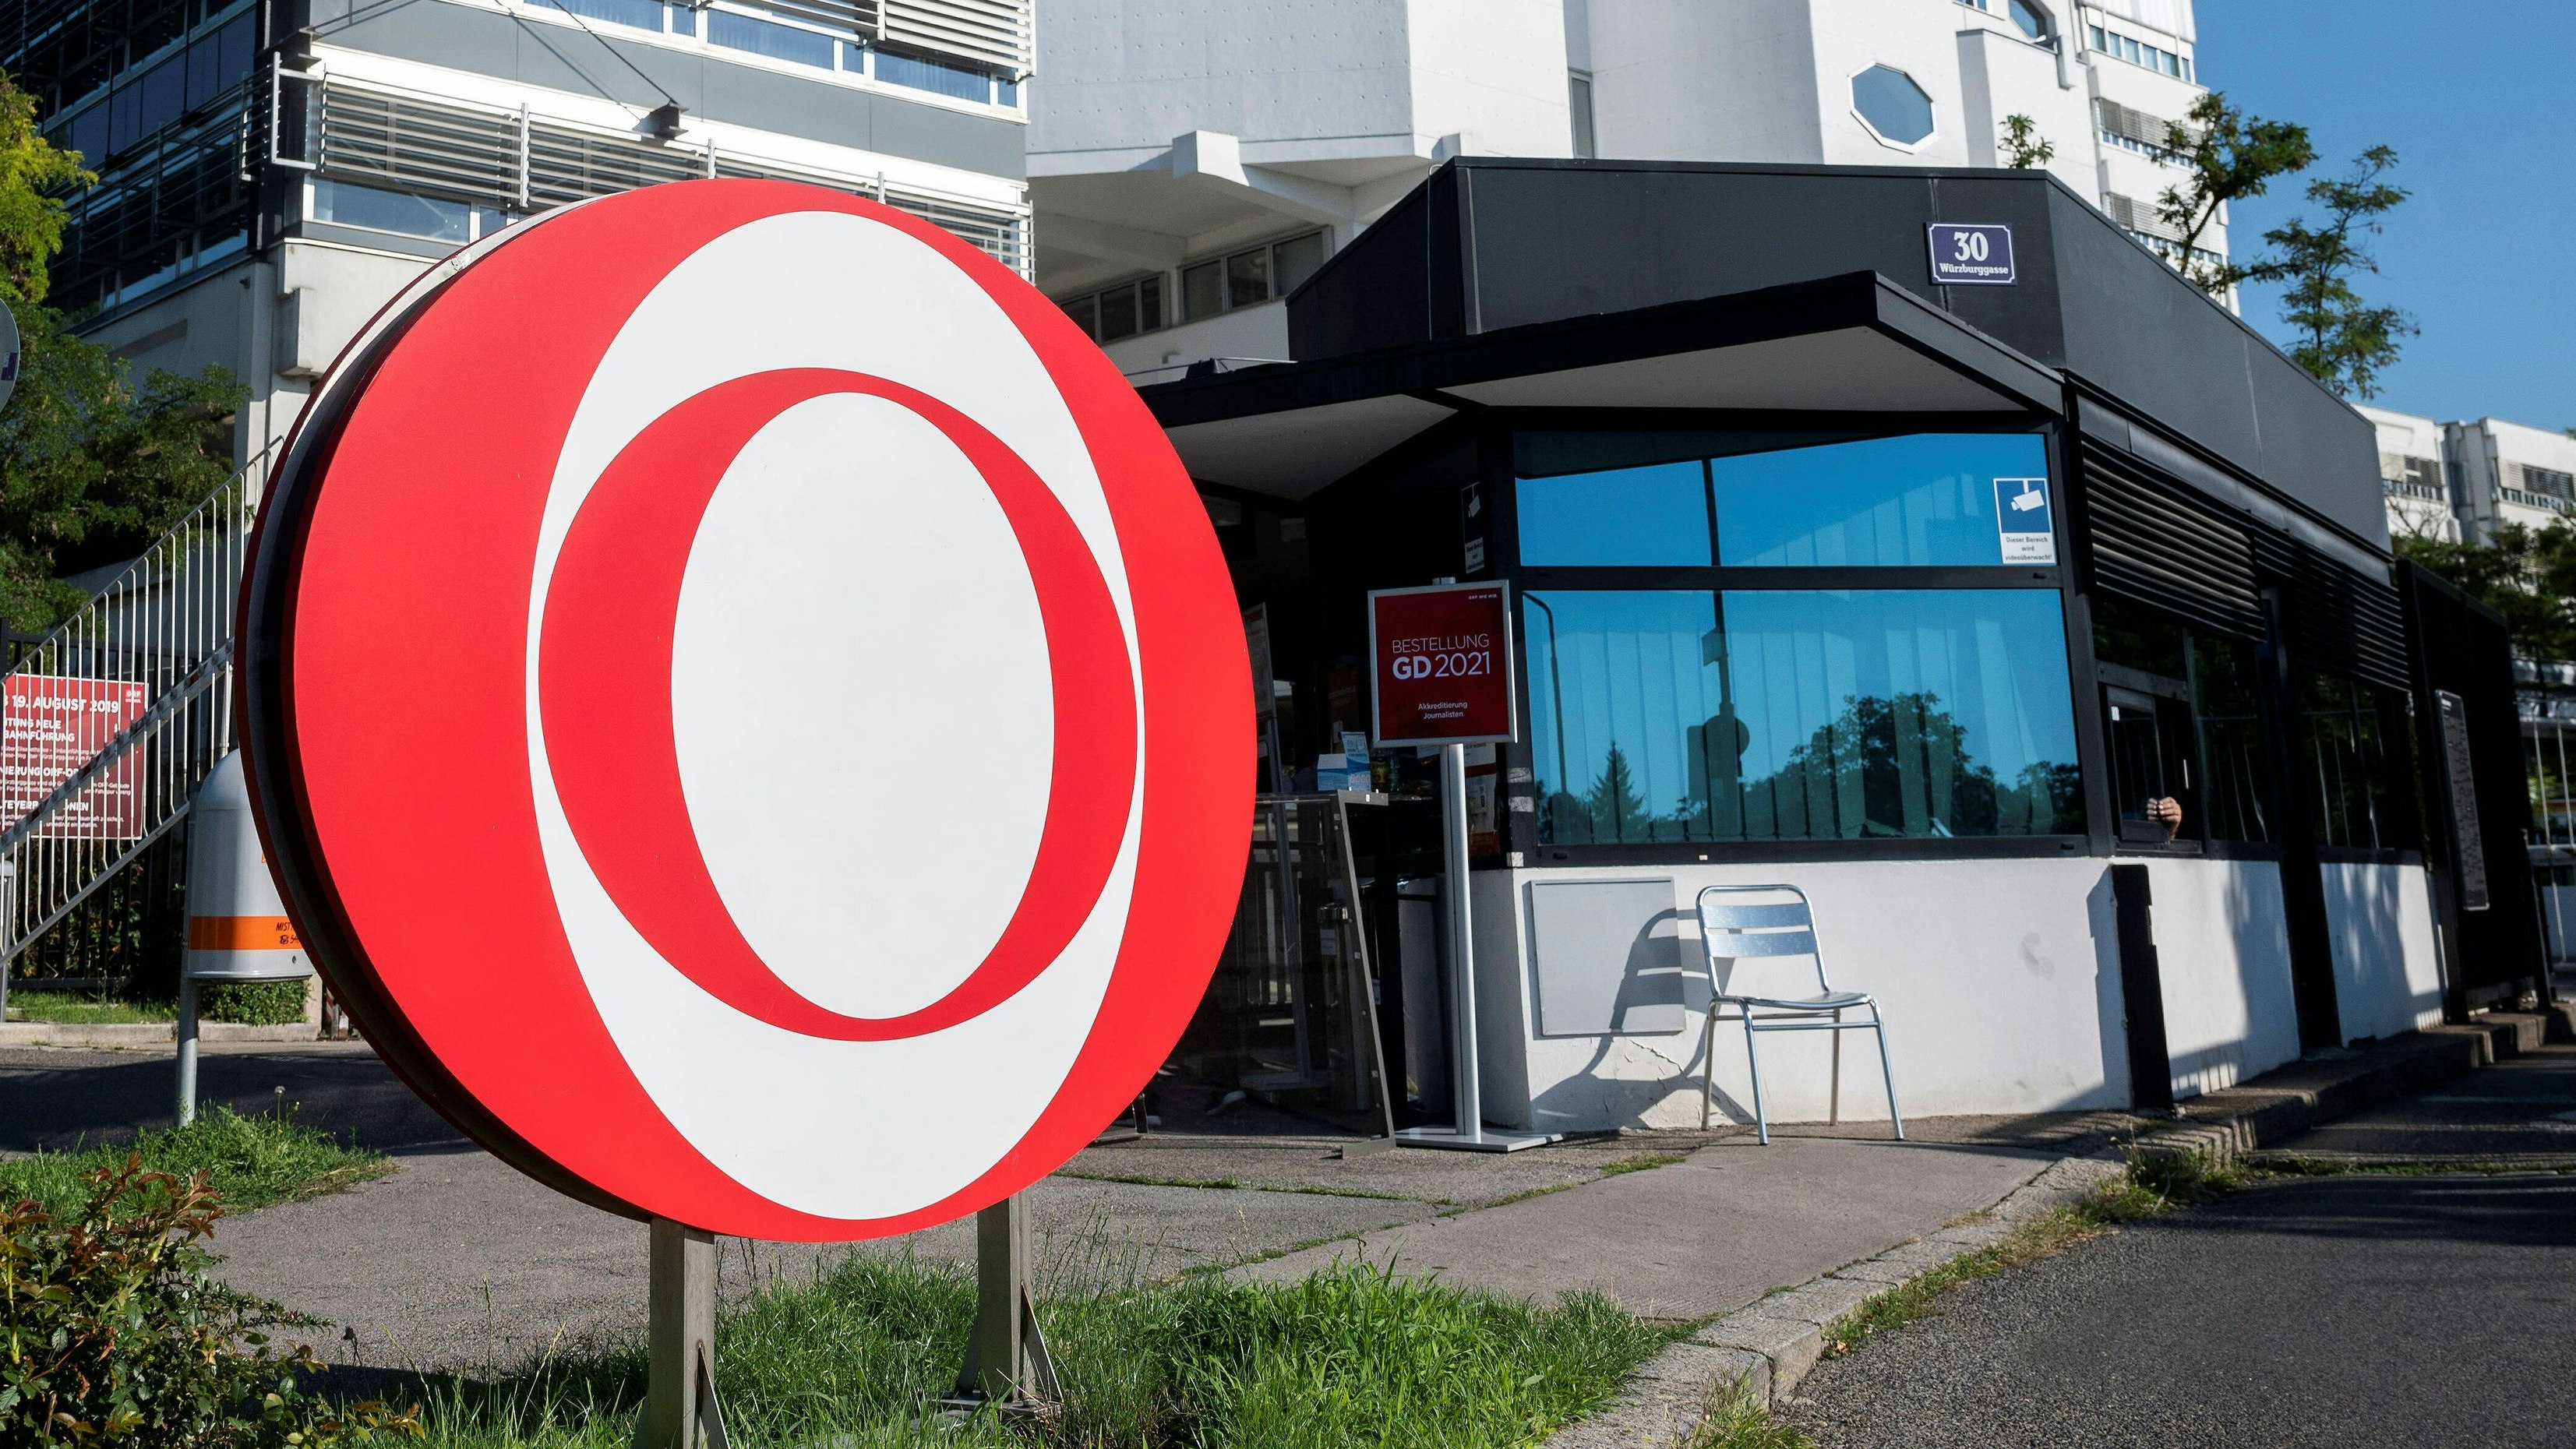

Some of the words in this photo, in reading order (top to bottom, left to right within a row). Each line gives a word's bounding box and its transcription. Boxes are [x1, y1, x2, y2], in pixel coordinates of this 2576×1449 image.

[1953, 231, 1988, 262] 30
[1939, 263, 2009, 277] Würzburggasse
[1392, 633, 1490, 654] BESTELLUNG
[32, 696, 87, 711] AUGUST
[90, 700, 119, 714] 2019
[1418, 701, 1468, 710] Akkreditierung
[1423, 710, 1464, 719] Journalisten
